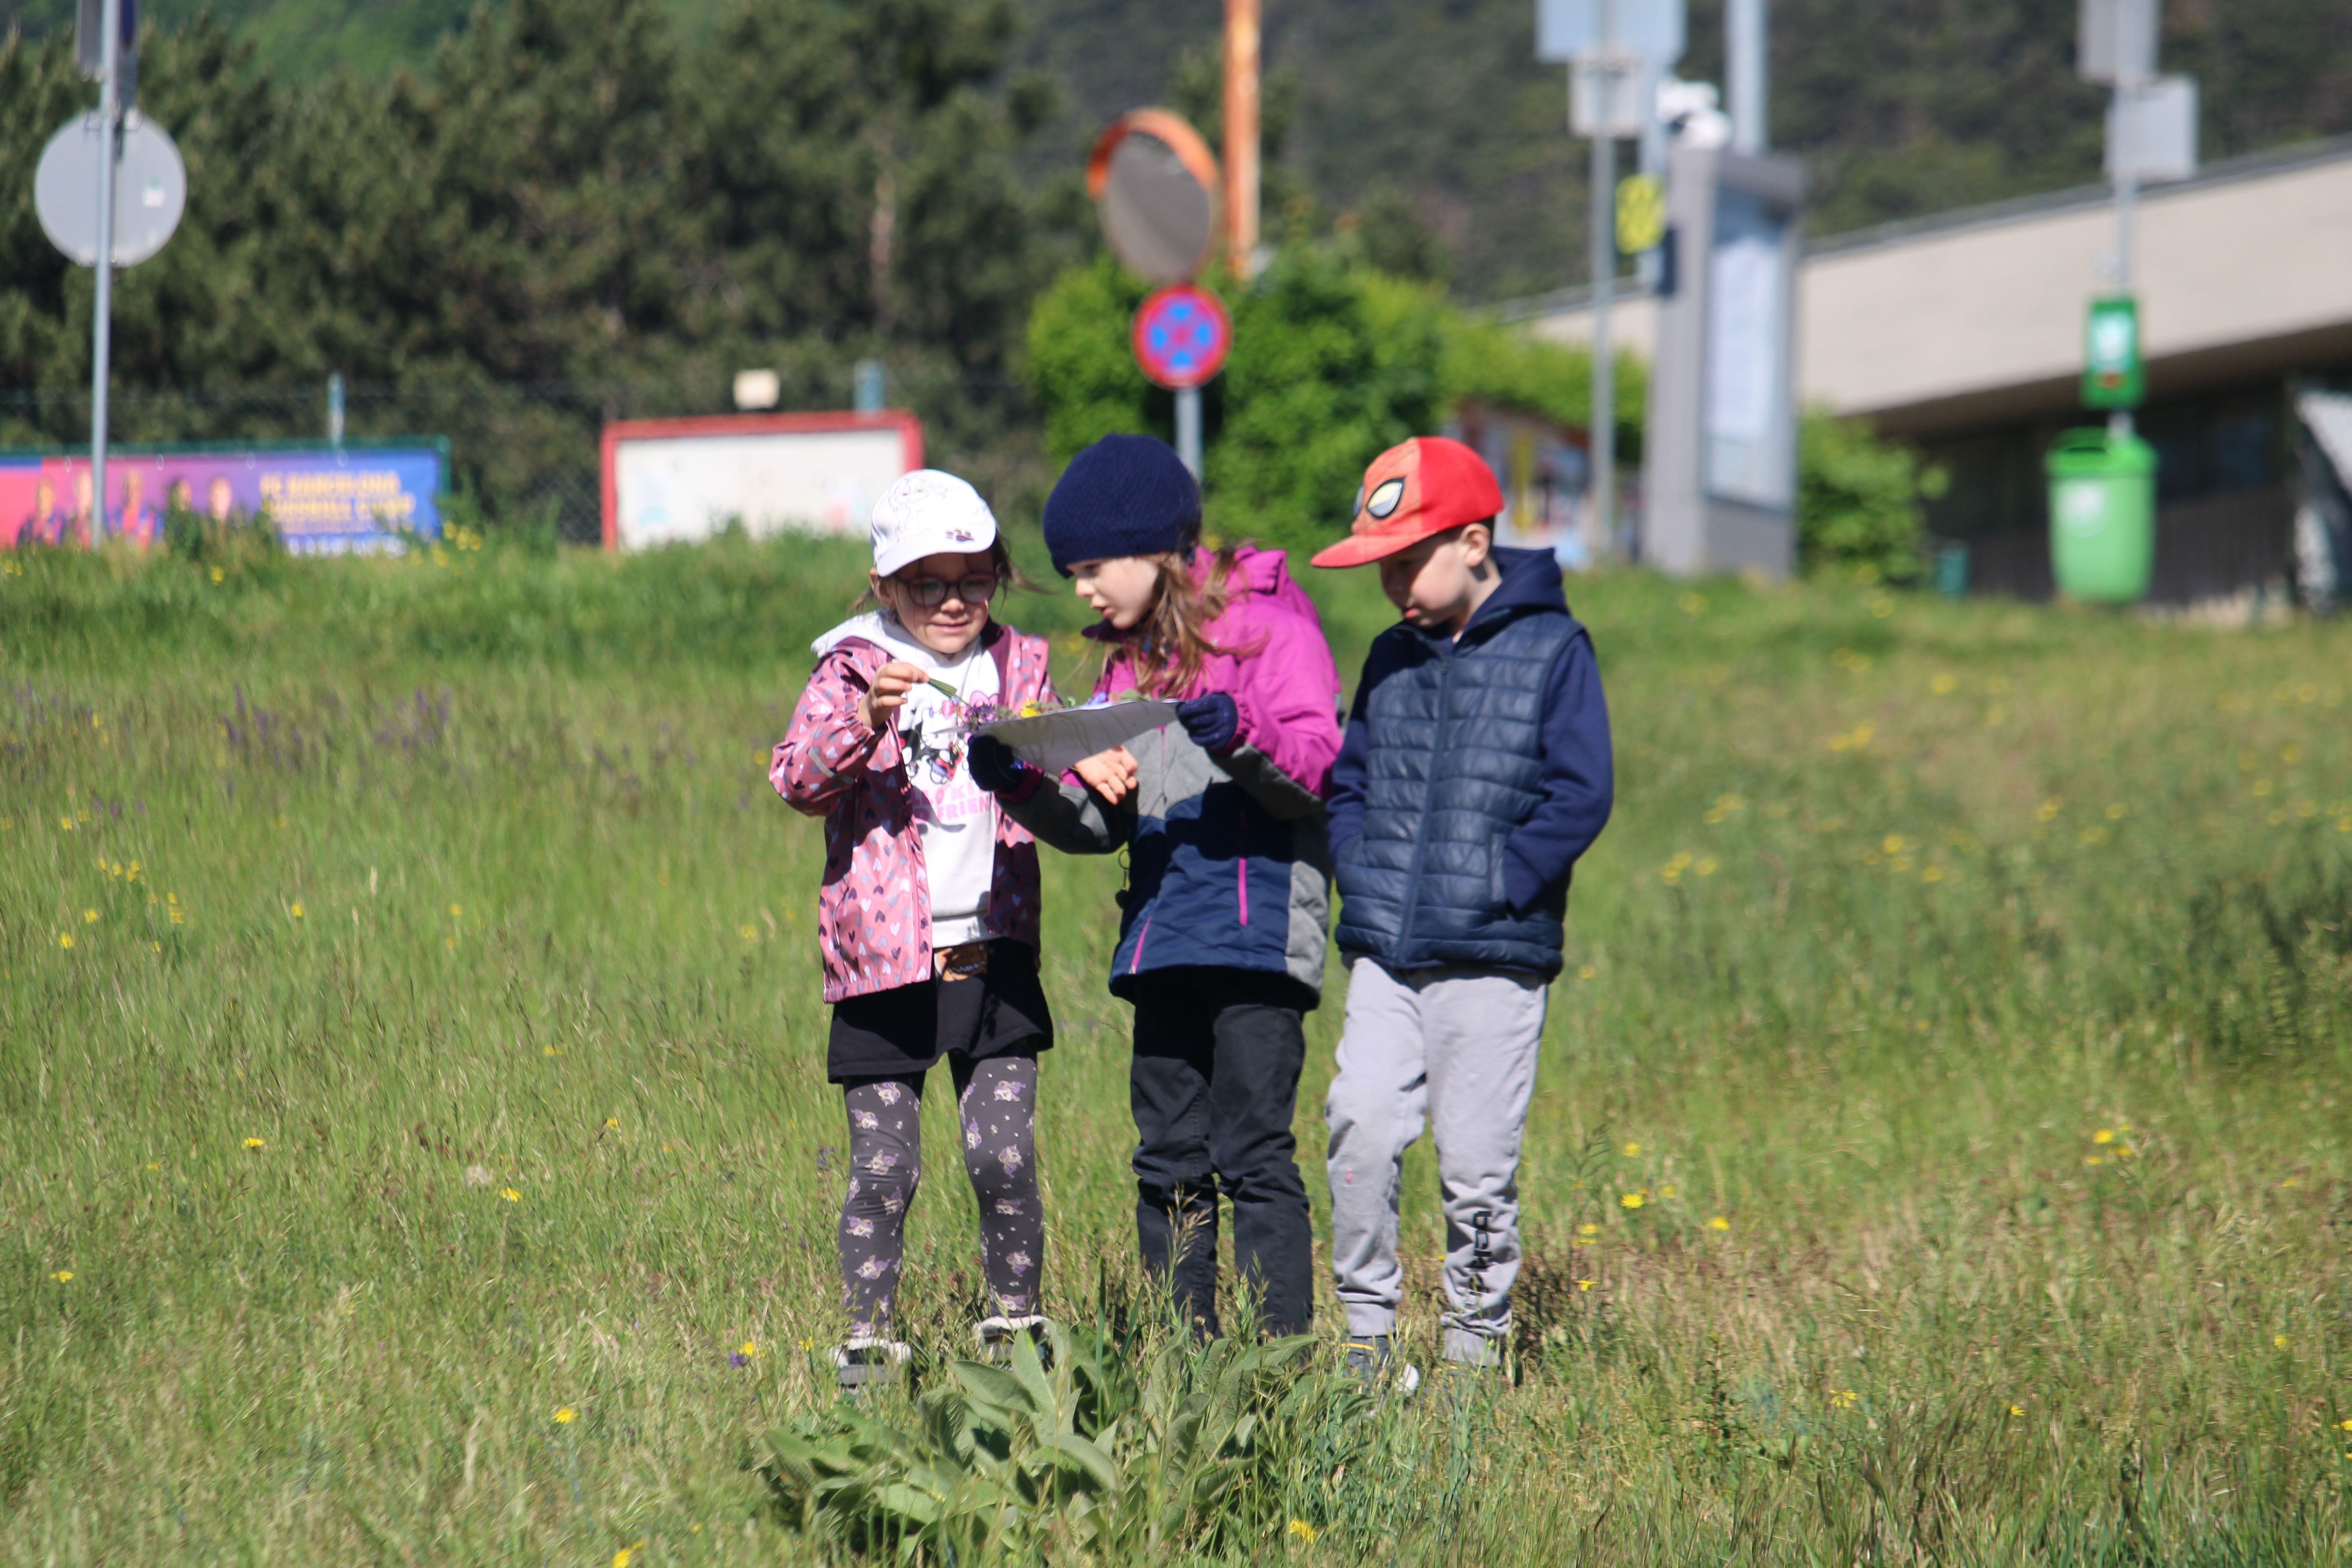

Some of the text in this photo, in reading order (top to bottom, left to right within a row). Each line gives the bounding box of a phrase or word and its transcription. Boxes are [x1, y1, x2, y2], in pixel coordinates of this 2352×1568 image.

[911, 781, 984, 806] LLO KI
[936, 796, 990, 820] FRIEN
